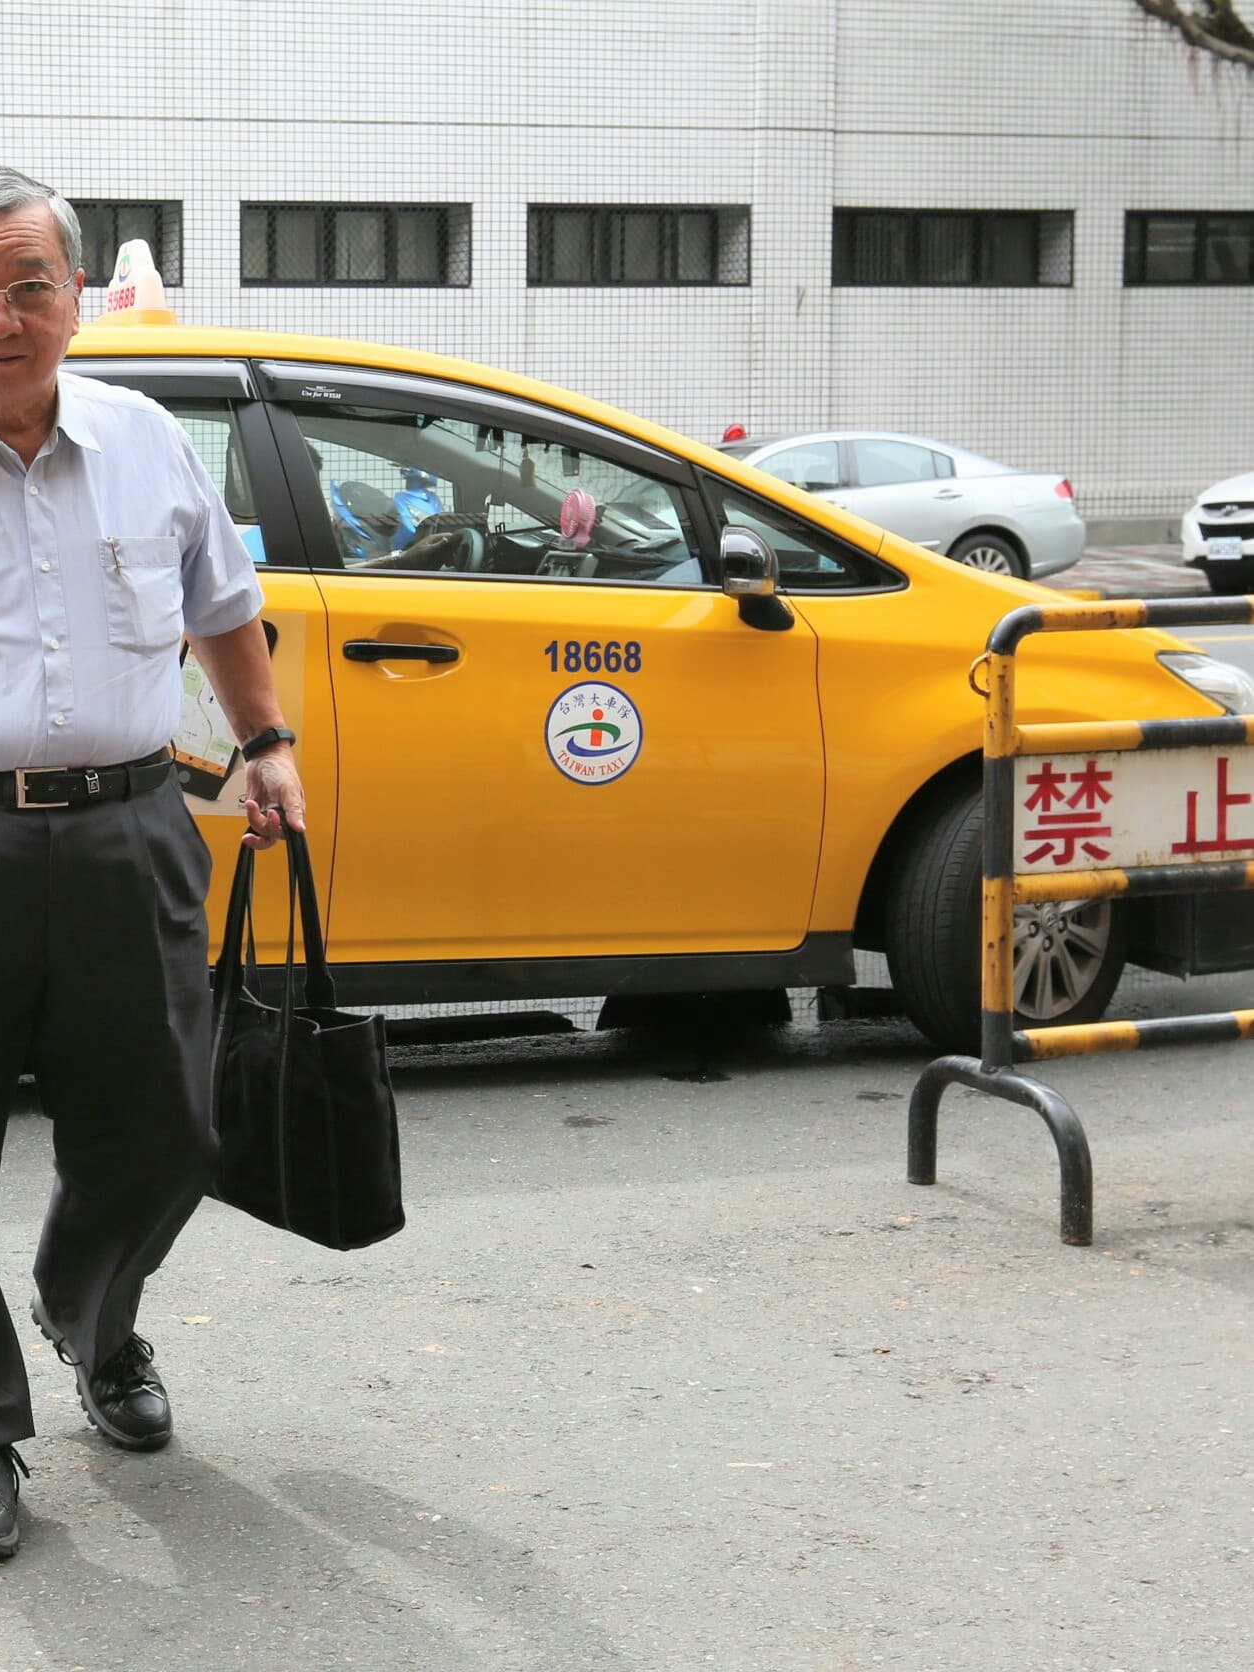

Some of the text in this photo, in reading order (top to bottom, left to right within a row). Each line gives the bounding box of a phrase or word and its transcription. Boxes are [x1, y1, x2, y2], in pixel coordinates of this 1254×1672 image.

[107, 286, 136, 312] 55688
[544, 640, 642, 673] 18668
[559, 692, 632, 720] 台灣大車隊
[557, 750, 625, 776] TAIWAN TAXI
